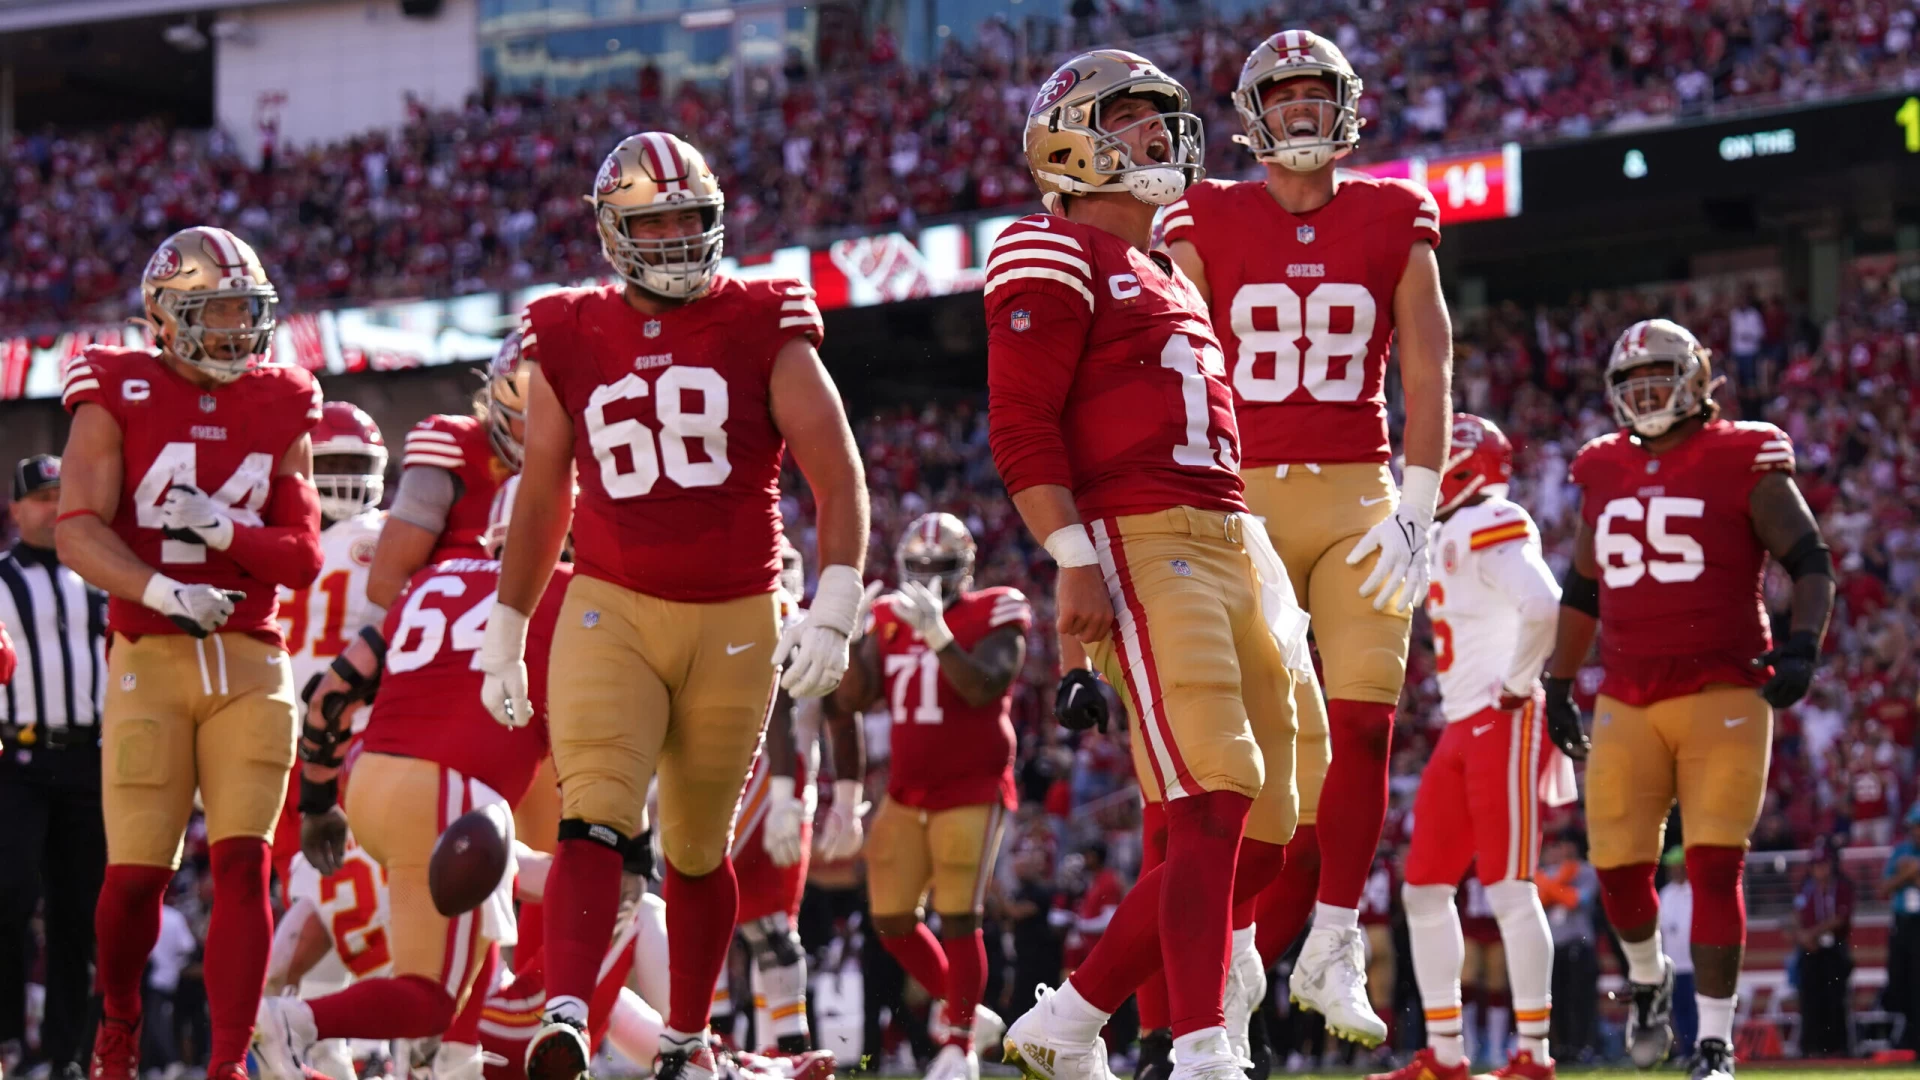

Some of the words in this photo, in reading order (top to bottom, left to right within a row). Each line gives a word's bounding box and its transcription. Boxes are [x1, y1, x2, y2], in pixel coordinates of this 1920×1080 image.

[1719, 134, 1752, 161] ON
[1753, 128, 1796, 156] THE
[1444, 161, 1488, 208] 14
[1108, 273, 1141, 300] C
[1285, 264, 1325, 277] 49ERS
[634, 352, 673, 370] 49ERS
[1230, 282, 1376, 402] 88
[122, 379, 151, 400] C
[584, 365, 733, 500] 68
[134, 442, 274, 564] 44
[1595, 497, 1705, 589] 65
[386, 575, 499, 676] 64
[884, 649, 944, 724] 71
[320, 857, 393, 980] 2
[1022, 1042, 1056, 1077] adidas
